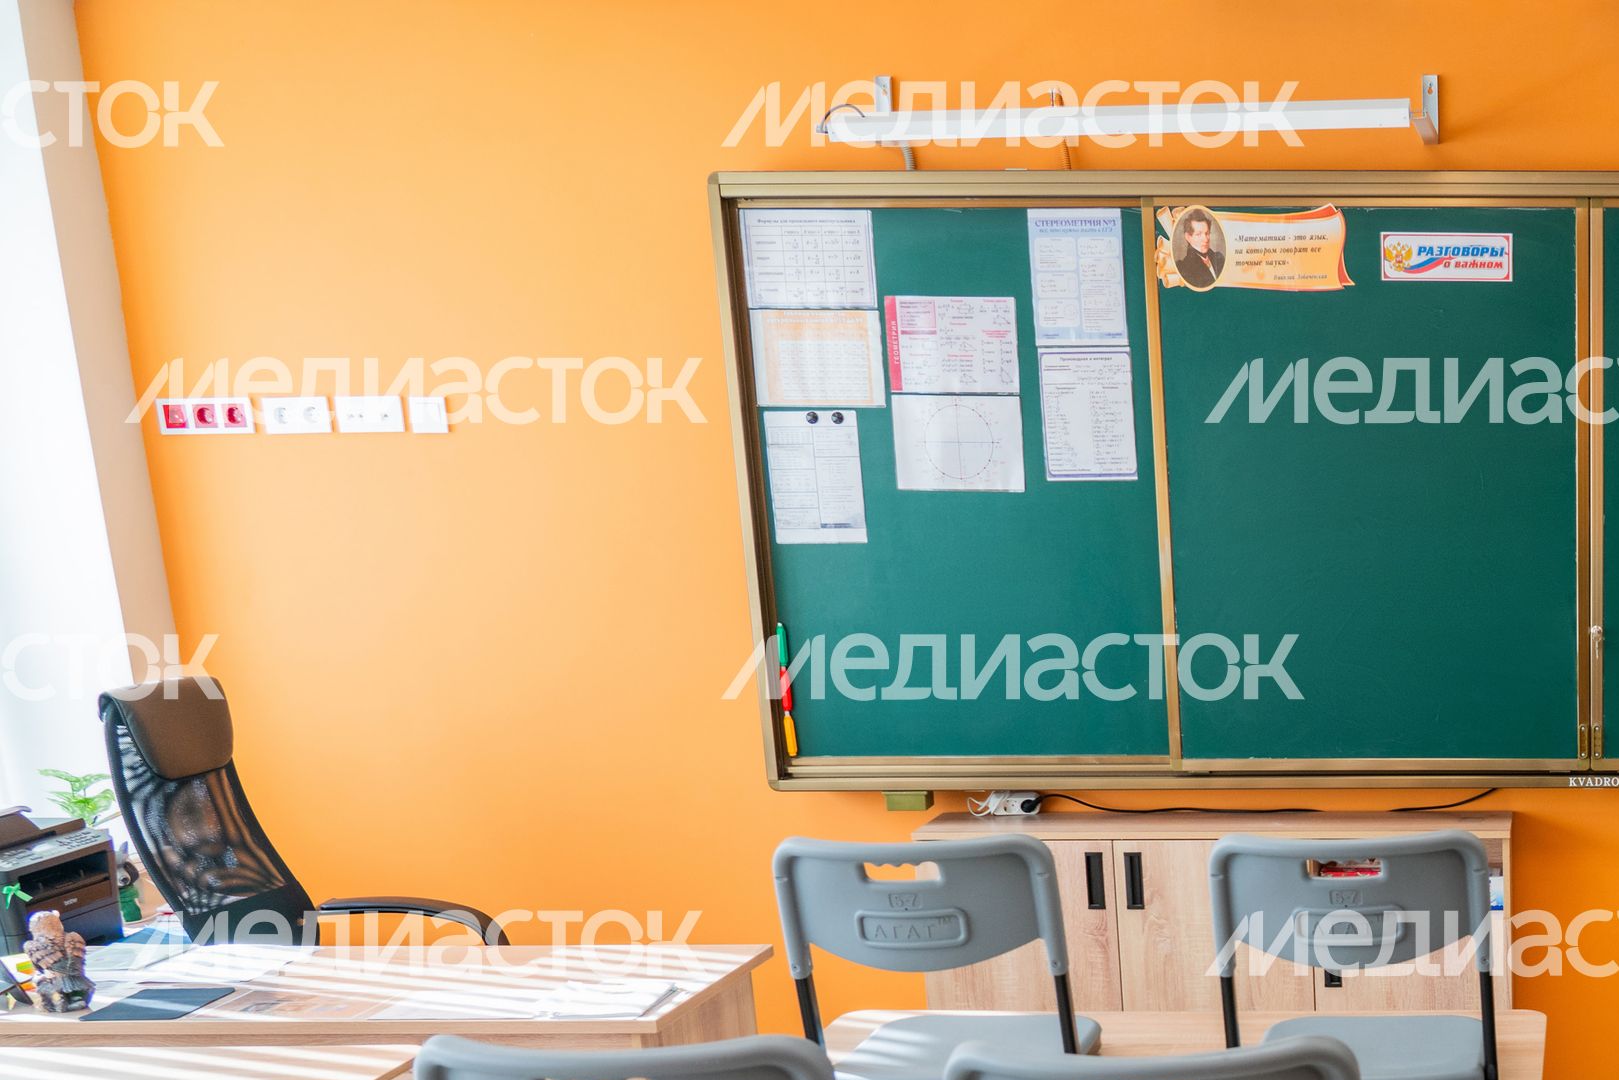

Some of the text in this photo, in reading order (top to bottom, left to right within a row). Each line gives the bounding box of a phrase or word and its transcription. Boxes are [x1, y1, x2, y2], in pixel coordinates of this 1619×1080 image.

[1417, 246, 1505, 257] РАЗГОВОРЫ
[1454, 260, 1503, 269] важном
[1569, 777, 1619, 787] KVADRO
